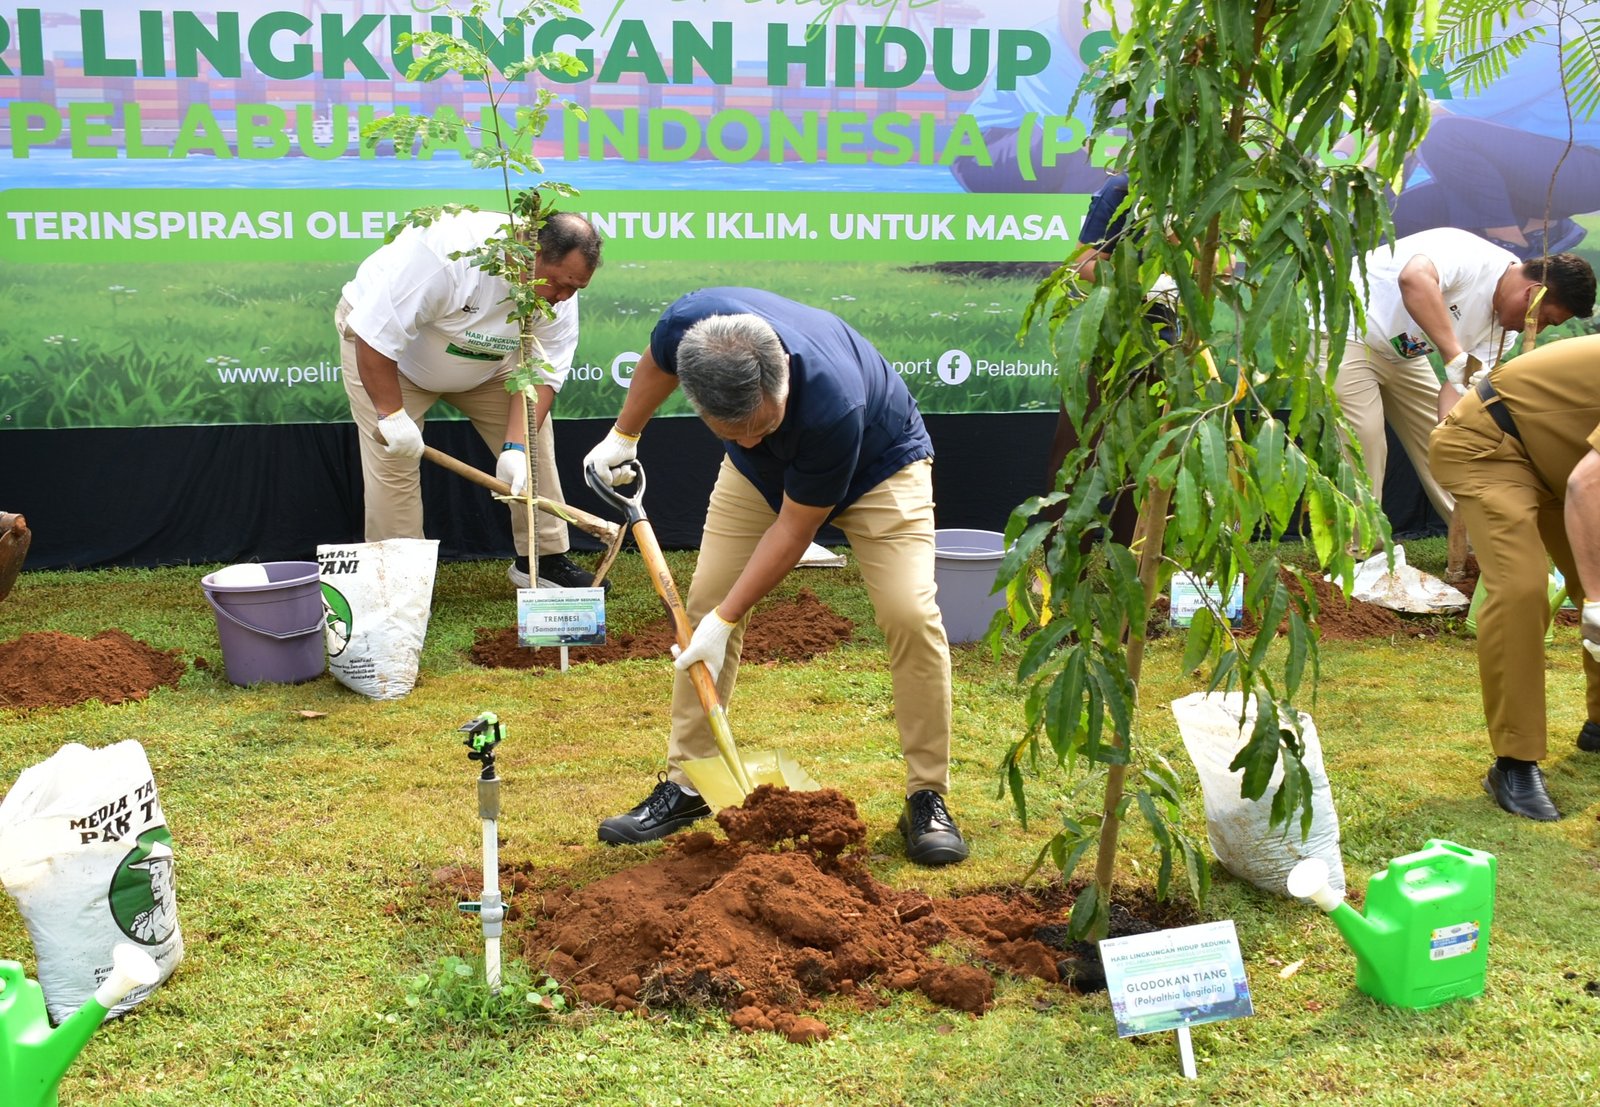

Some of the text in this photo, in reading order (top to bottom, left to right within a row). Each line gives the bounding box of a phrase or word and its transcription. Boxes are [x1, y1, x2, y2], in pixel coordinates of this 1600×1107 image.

[80, 9, 733, 85] LINGKUNGAN
[767, 22, 1052, 92] HIDUP
[9, 102, 534, 162] PELABUHAN
[563, 106, 993, 167] INDONESIA
[7, 210, 294, 241] TERINSPIRASI
[580, 211, 696, 240] NTUK
[706, 212, 818, 240] IKLIM.
[830, 213, 955, 241] UNTUK
[966, 214, 1069, 241] MASA
[465, 330, 484, 341] HARI
[467, 339, 492, 348] HIDUP
[319, 560, 360, 575] ANI
[69, 794, 128, 830] MEDIA
[80, 810, 132, 845] PAK
[1111, 955, 1128, 963] HARI
[1130, 948, 1175, 960] LINGKUNGAN
[1176, 943, 1199, 952] HIDUP
[1200, 938, 1232, 949] SEDUNIA
[1126, 968, 1228, 993] GLODOKAN TIANG
[1134, 983, 1226, 1007] (Polyalthia longifolia)
